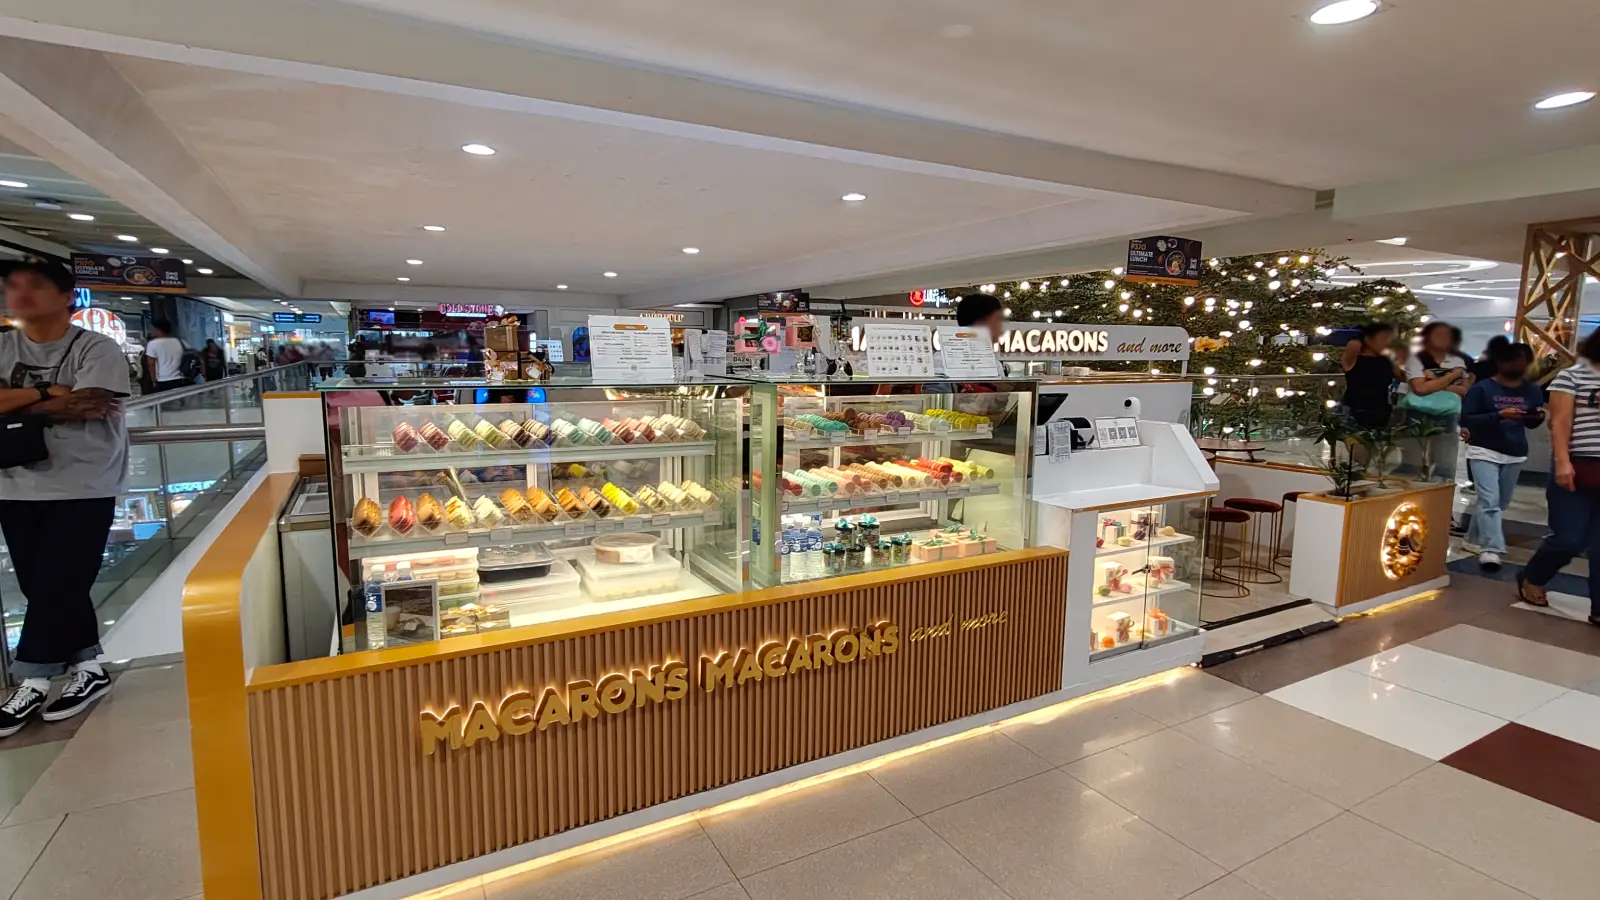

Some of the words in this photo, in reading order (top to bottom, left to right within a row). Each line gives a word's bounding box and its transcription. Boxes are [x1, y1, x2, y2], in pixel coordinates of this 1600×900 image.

[438, 303, 463, 314] COLD
[464, 303, 494, 315] STONE
[994, 329, 1109, 353] MACARONS
[1116, 336, 1146, 354] and
[1149, 342, 1182, 353] more
[420, 662, 688, 756] MACARONS
[700, 621, 899, 692] MACARONS
[909, 613, 954, 643] and
[960, 608, 1009, 633] more
